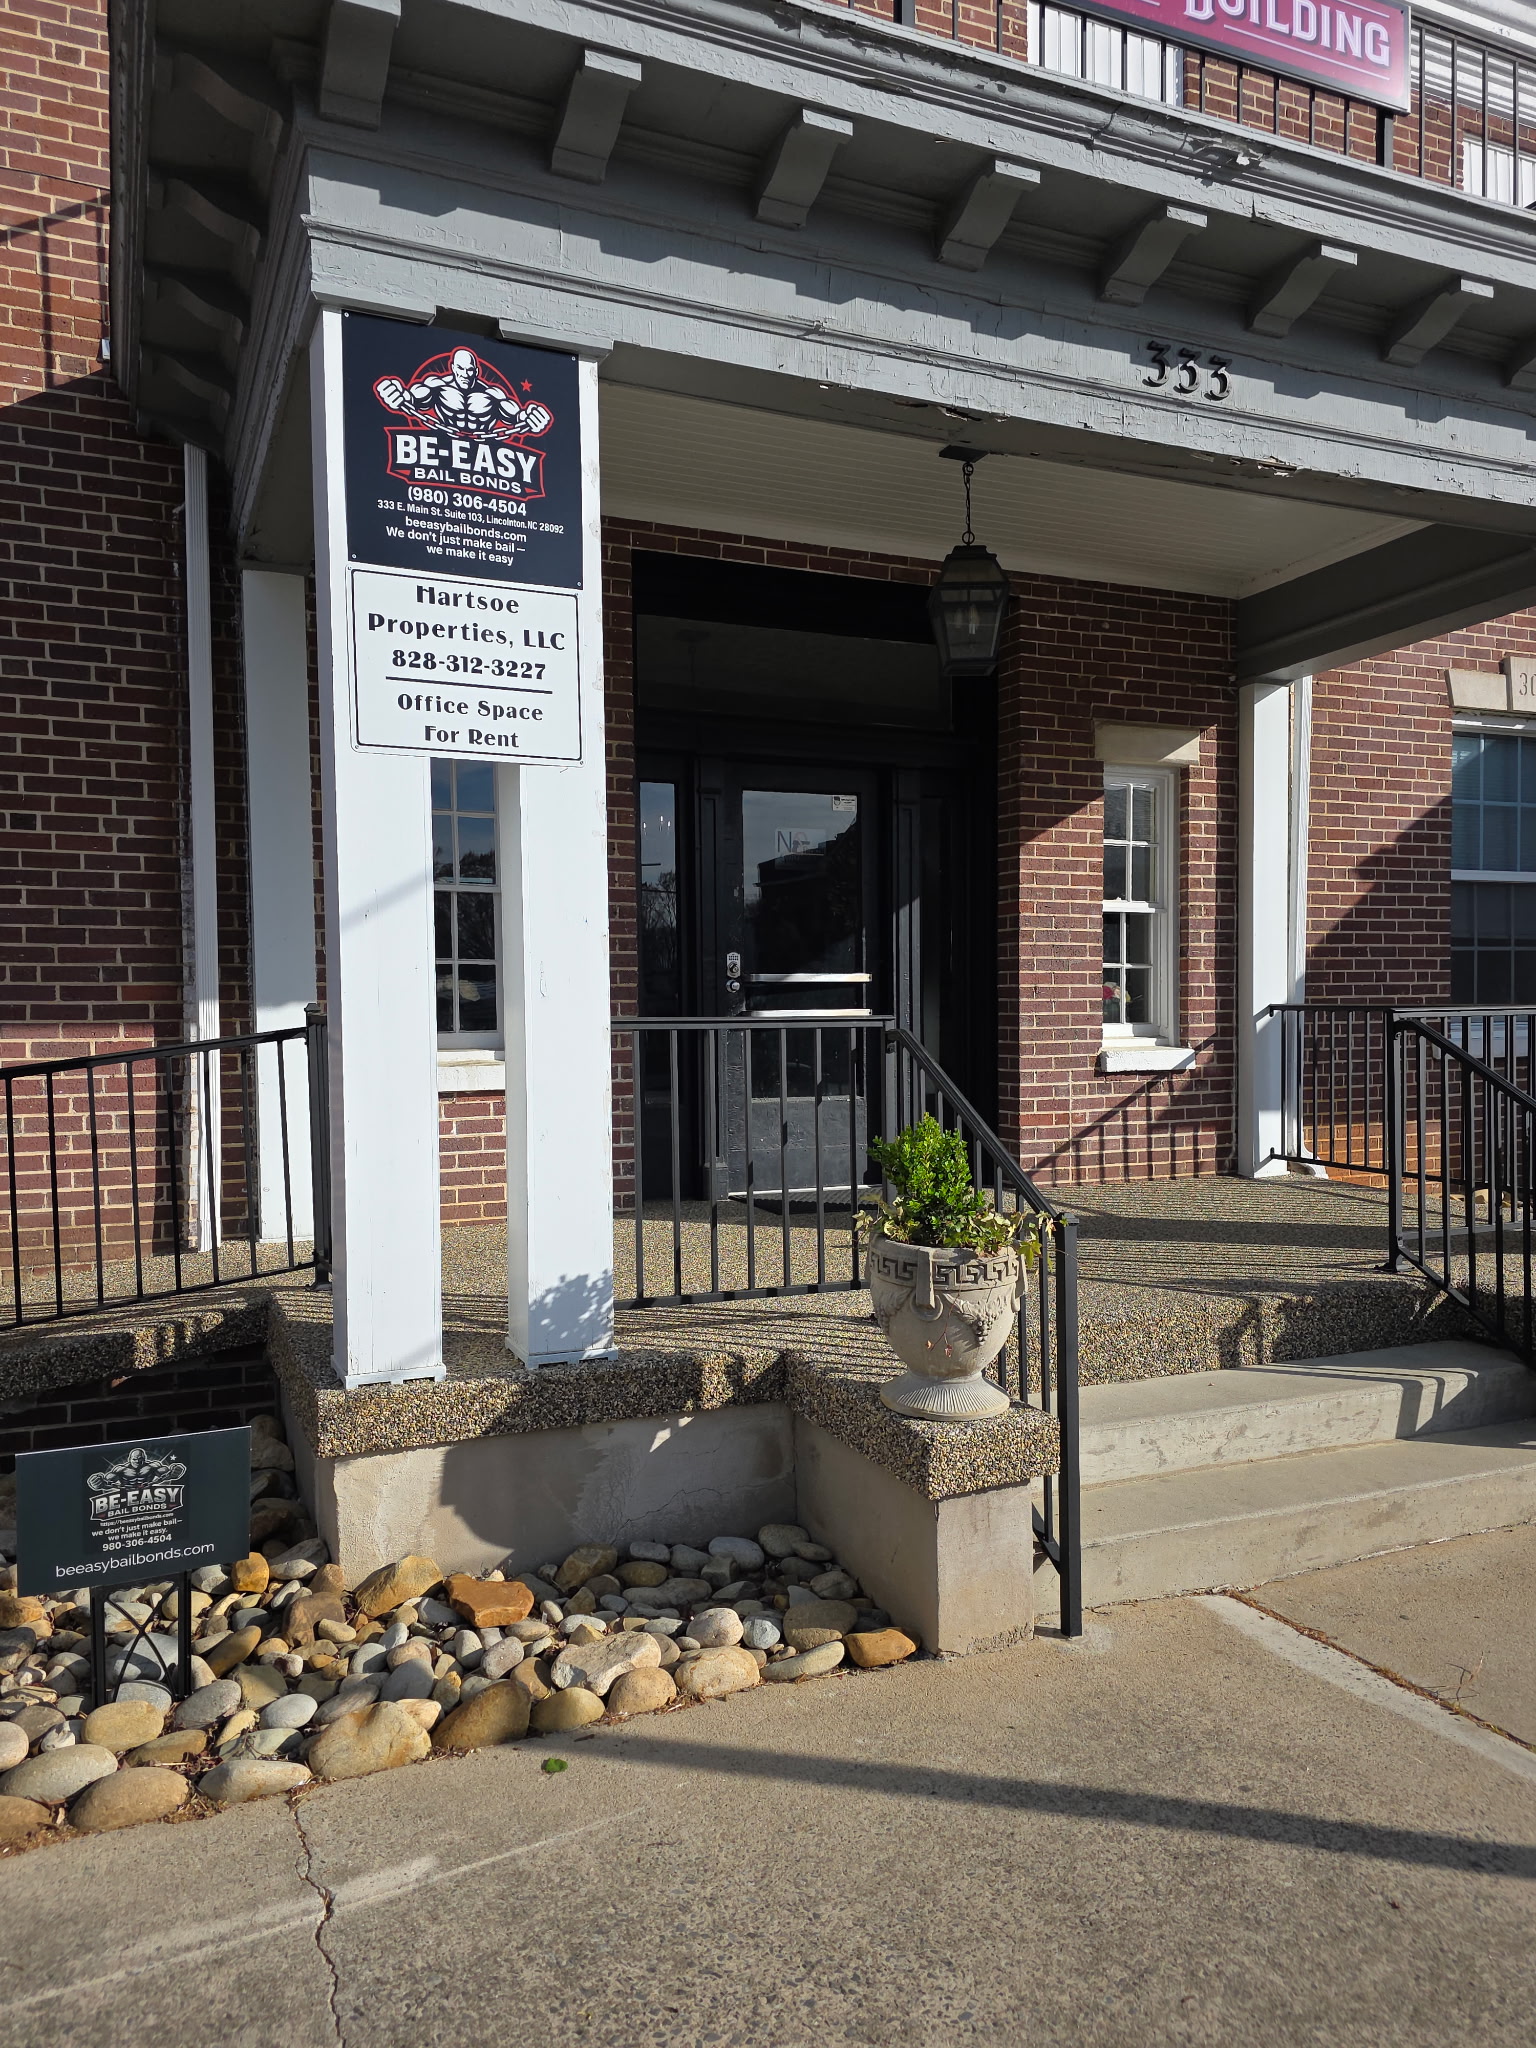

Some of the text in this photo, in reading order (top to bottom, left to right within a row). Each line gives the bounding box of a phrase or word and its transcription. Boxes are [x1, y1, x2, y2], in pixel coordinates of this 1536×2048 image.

[1143, 340, 1233, 401] 333
[395, 434, 537, 484] BE-EASY
[414, 467, 522, 494] BAIL BONDS
[408, 485, 527, 516] (980) 306-4504
[377, 499, 395, 510] 333
[397, 501, 406, 512] E.
[407, 503, 429, 515] Main
[430, 506, 443, 517] St.
[444, 508, 467, 520] Suite
[468, 511, 486, 524] 103,
[527, 520, 538, 530] NC
[539, 522, 564, 535] 28092
[405, 515, 527, 543] beeasybailbonds.com
[386, 525, 405, 538] We
[407, 529, 437, 543] don't
[439, 532, 461, 546] just
[462, 537, 493, 550] make
[495, 540, 515, 553] bail
[426, 545, 514, 567] we make it easy
[416, 585, 520, 614] Hartsoe
[368, 612, 566, 651] Properties, LLC
[391, 649, 546, 680] 828-312-3227
[397, 693, 544, 721] Office Space
[424, 725, 520, 748] For Rent
[95, 1487, 180, 1514] BE-EASY
[107, 1503, 167, 1518] BAIL BONDS
[104, 1526, 125, 1535] don't
[126, 1523, 140, 1533] just
[141, 1520, 162, 1529] make
[121, 1531, 142, 1540] make
[102, 1533, 172, 1552] 980-306-4504
[55, 1543, 215, 1578] beeasybailbonds.com
